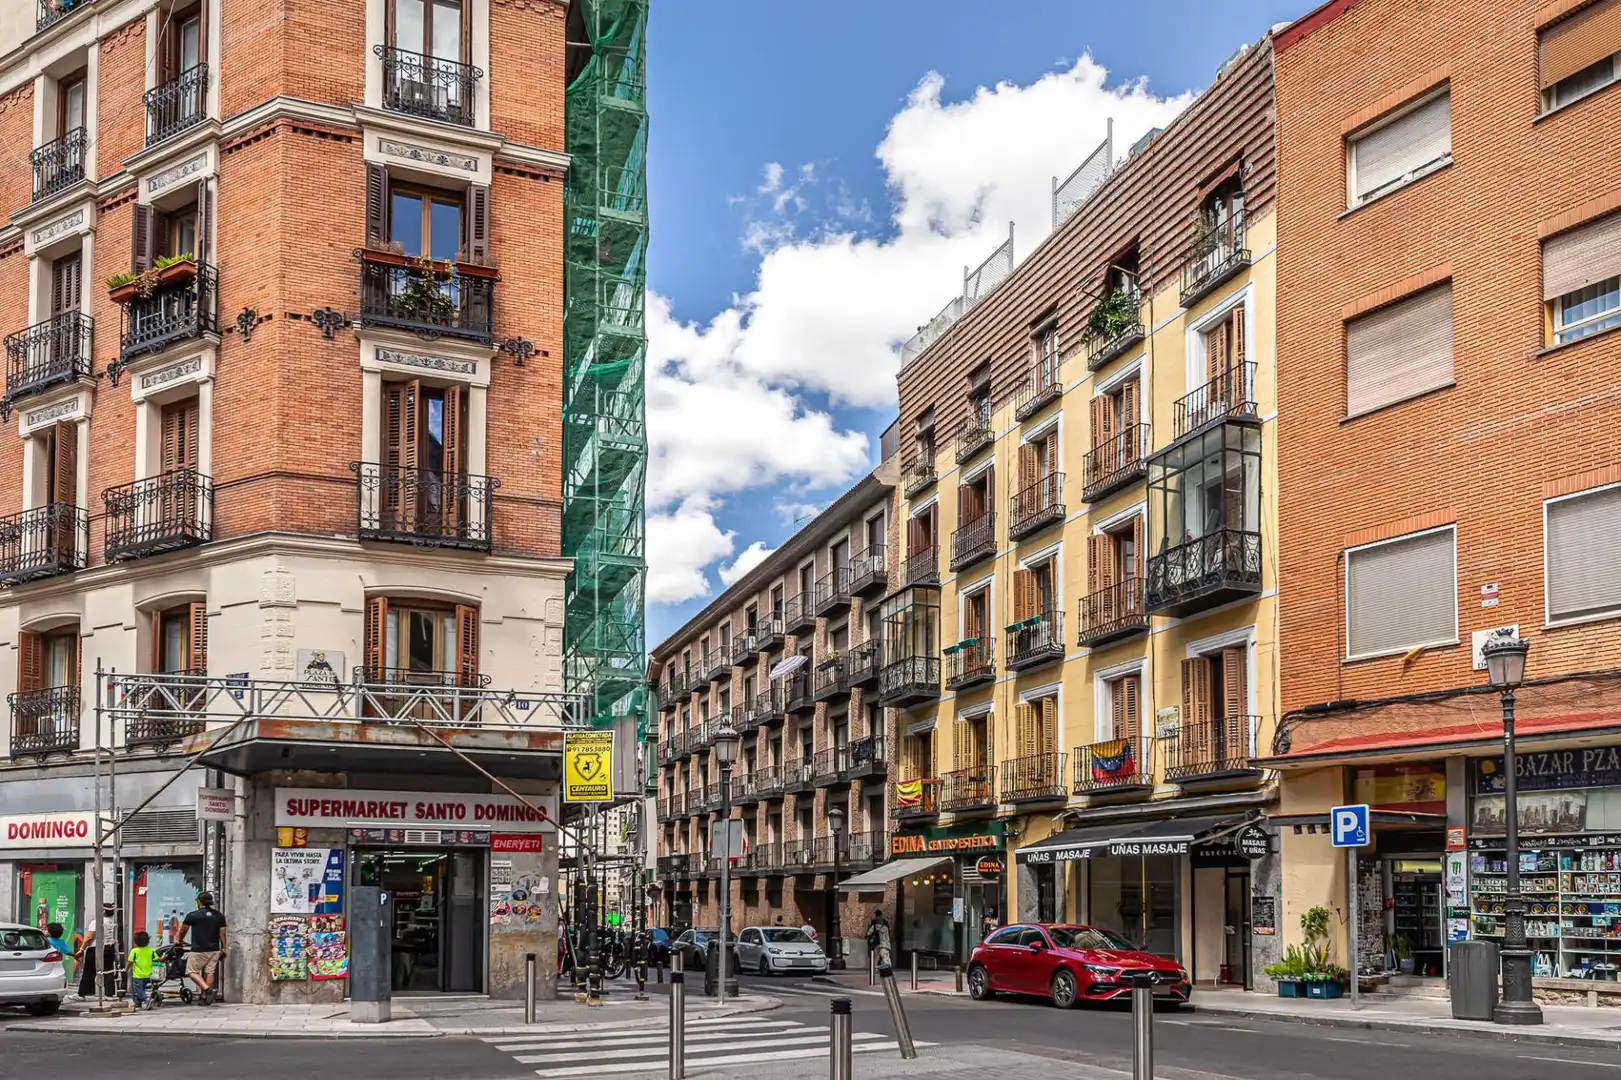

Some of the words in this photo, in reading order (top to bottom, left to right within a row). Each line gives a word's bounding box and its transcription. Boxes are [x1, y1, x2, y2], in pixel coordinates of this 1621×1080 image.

[517, 700, 528, 709] 10
[1515, 751, 1574, 777] BAZAR
[287, 798, 408, 819] SUPERMARKET
[415, 802, 466, 820] SANTO
[474, 804, 548, 822] DOMINGO
[8, 820, 88, 840] DOMINGO
[1337, 811, 1358, 843] P
[493, 839, 540, 850] ENERYETI
[892, 834, 926, 854] EDINA
[928, 839, 958, 852] CENTRO
[1111, 843, 1141, 855] UÑAS
[1142, 843, 1188, 855] MASAJE
[1242, 846, 1248, 854] Y
[1248, 846, 1266, 854] UÑAS
[1027, 852, 1050, 863] UÑAS
[1055, 849, 1091, 861] MASAJE
[380, 893, 387, 905] P
